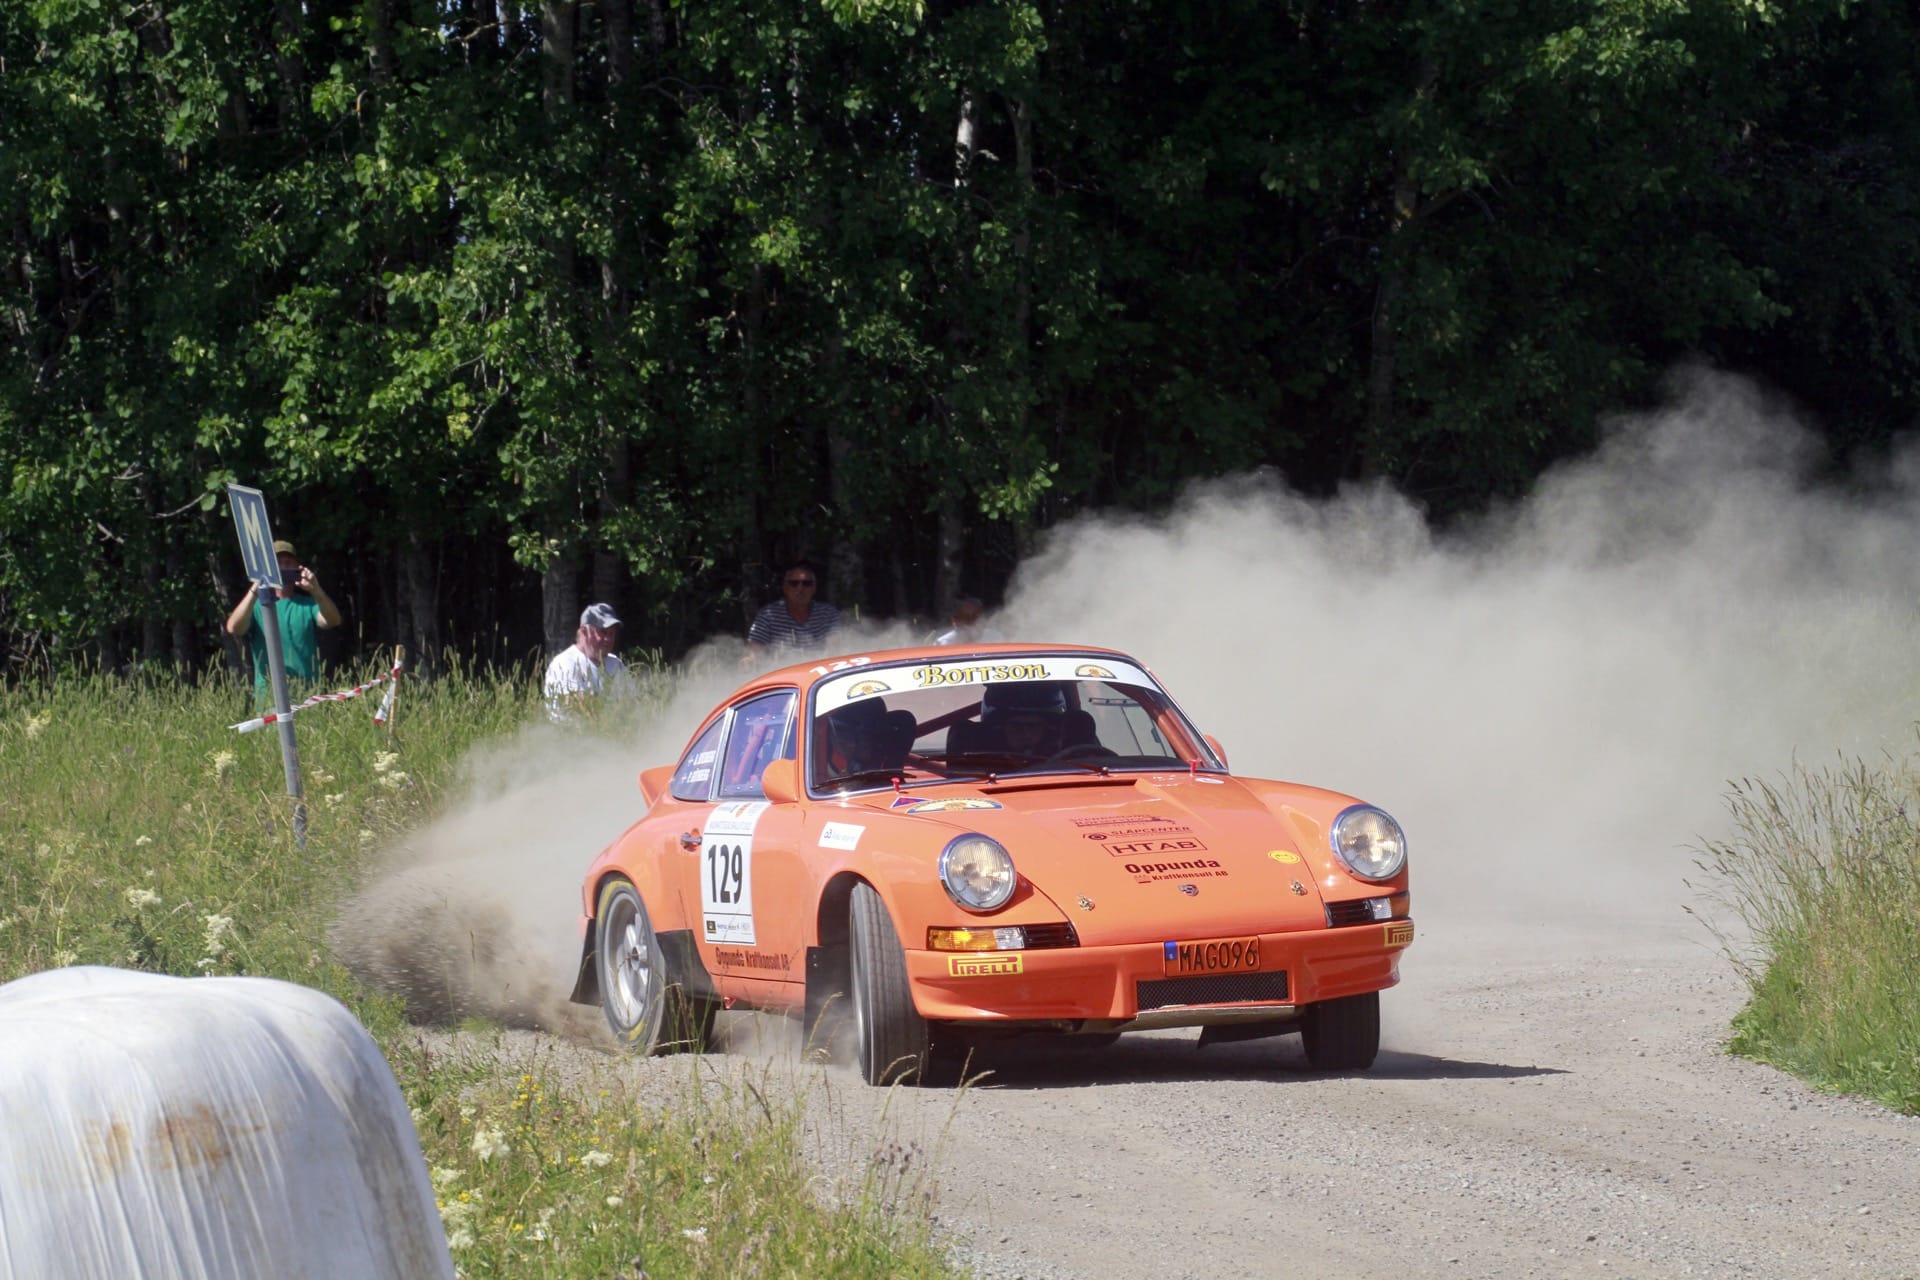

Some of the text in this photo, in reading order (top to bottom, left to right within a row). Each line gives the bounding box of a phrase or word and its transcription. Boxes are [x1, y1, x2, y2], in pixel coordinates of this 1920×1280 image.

[238, 496, 272, 577] M
[913, 663, 1051, 688] Borrson
[707, 843, 743, 905] 129
[1124, 859, 1221, 874] Oppunda
[951, 956, 1018, 975] PIRELLI
